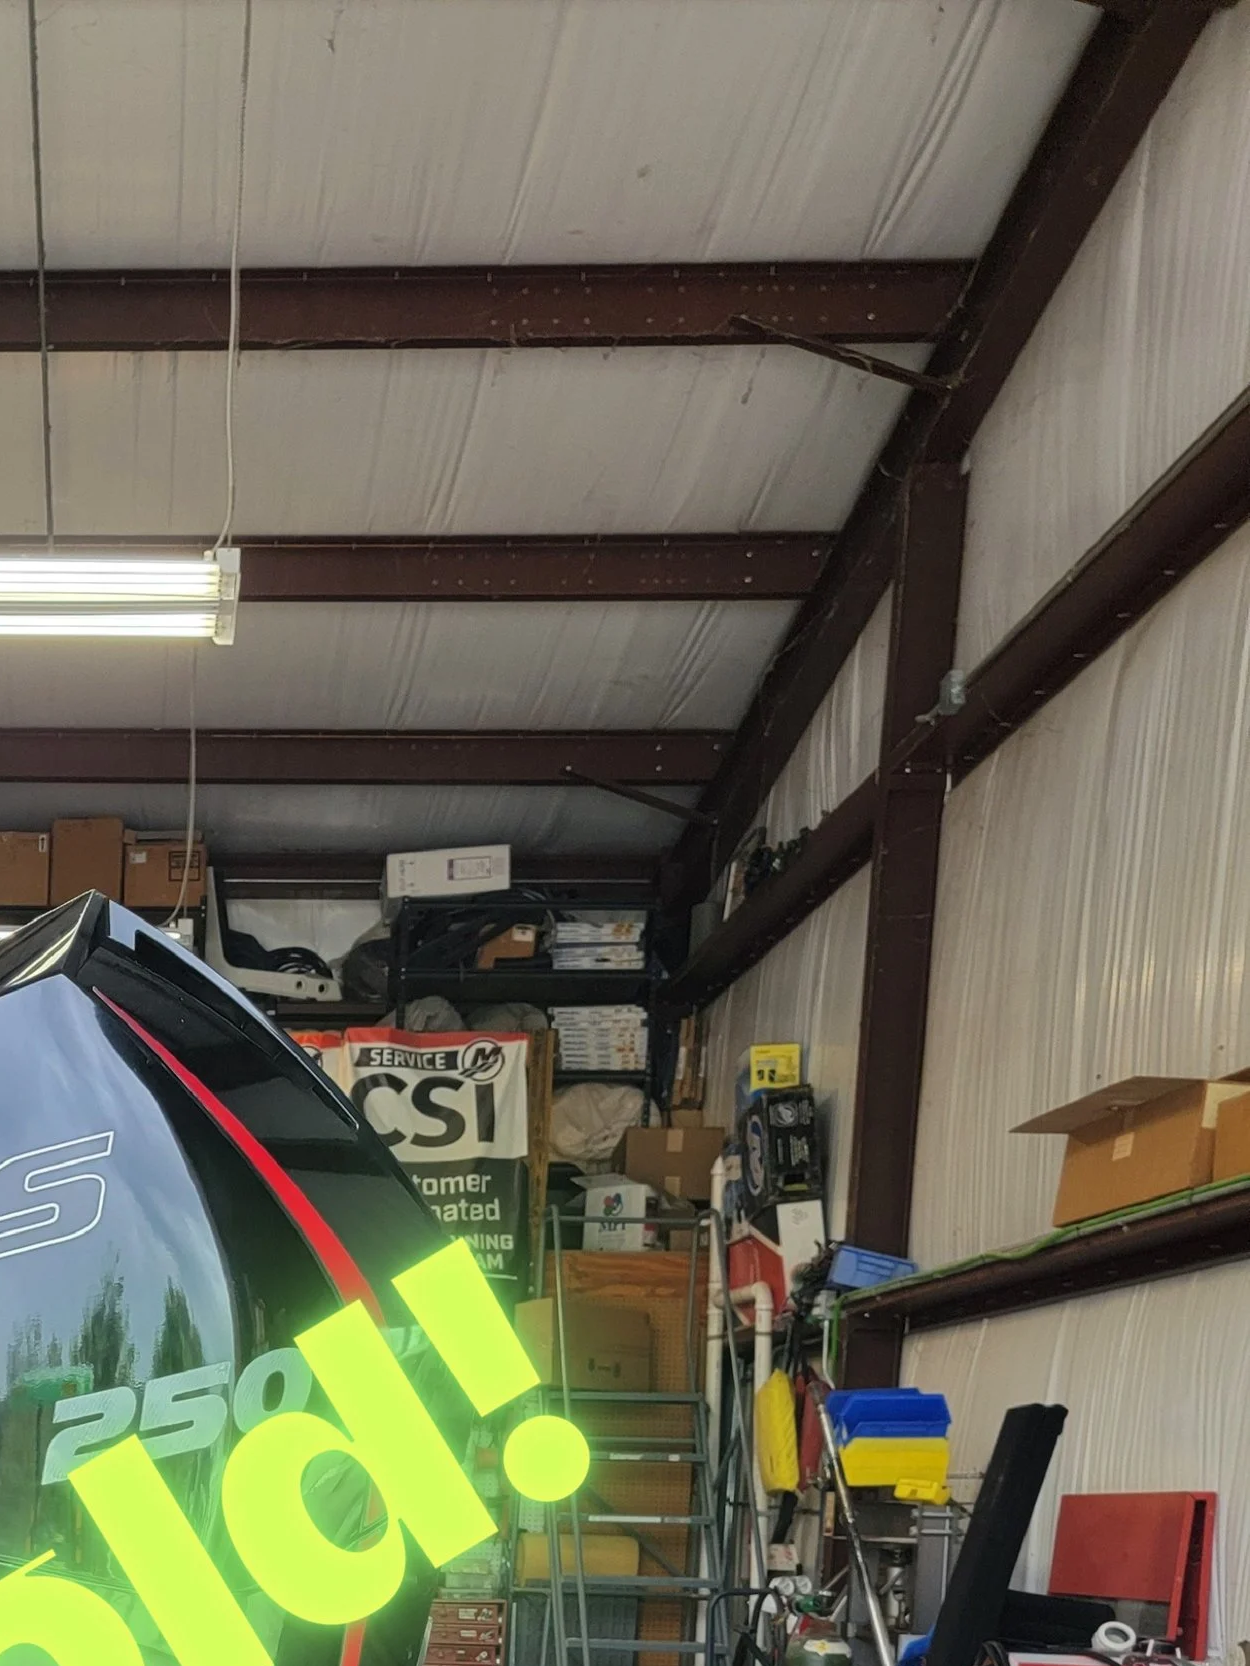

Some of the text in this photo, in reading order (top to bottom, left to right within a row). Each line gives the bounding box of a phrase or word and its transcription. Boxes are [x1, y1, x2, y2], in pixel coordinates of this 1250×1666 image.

[369, 1048, 447, 1070] SERVICE
[350, 1072, 496, 1148] CSI
[412, 1174, 492, 1196] tomer
[432, 1198, 500, 1222] nated
[41, 1347, 313, 1485] 250
